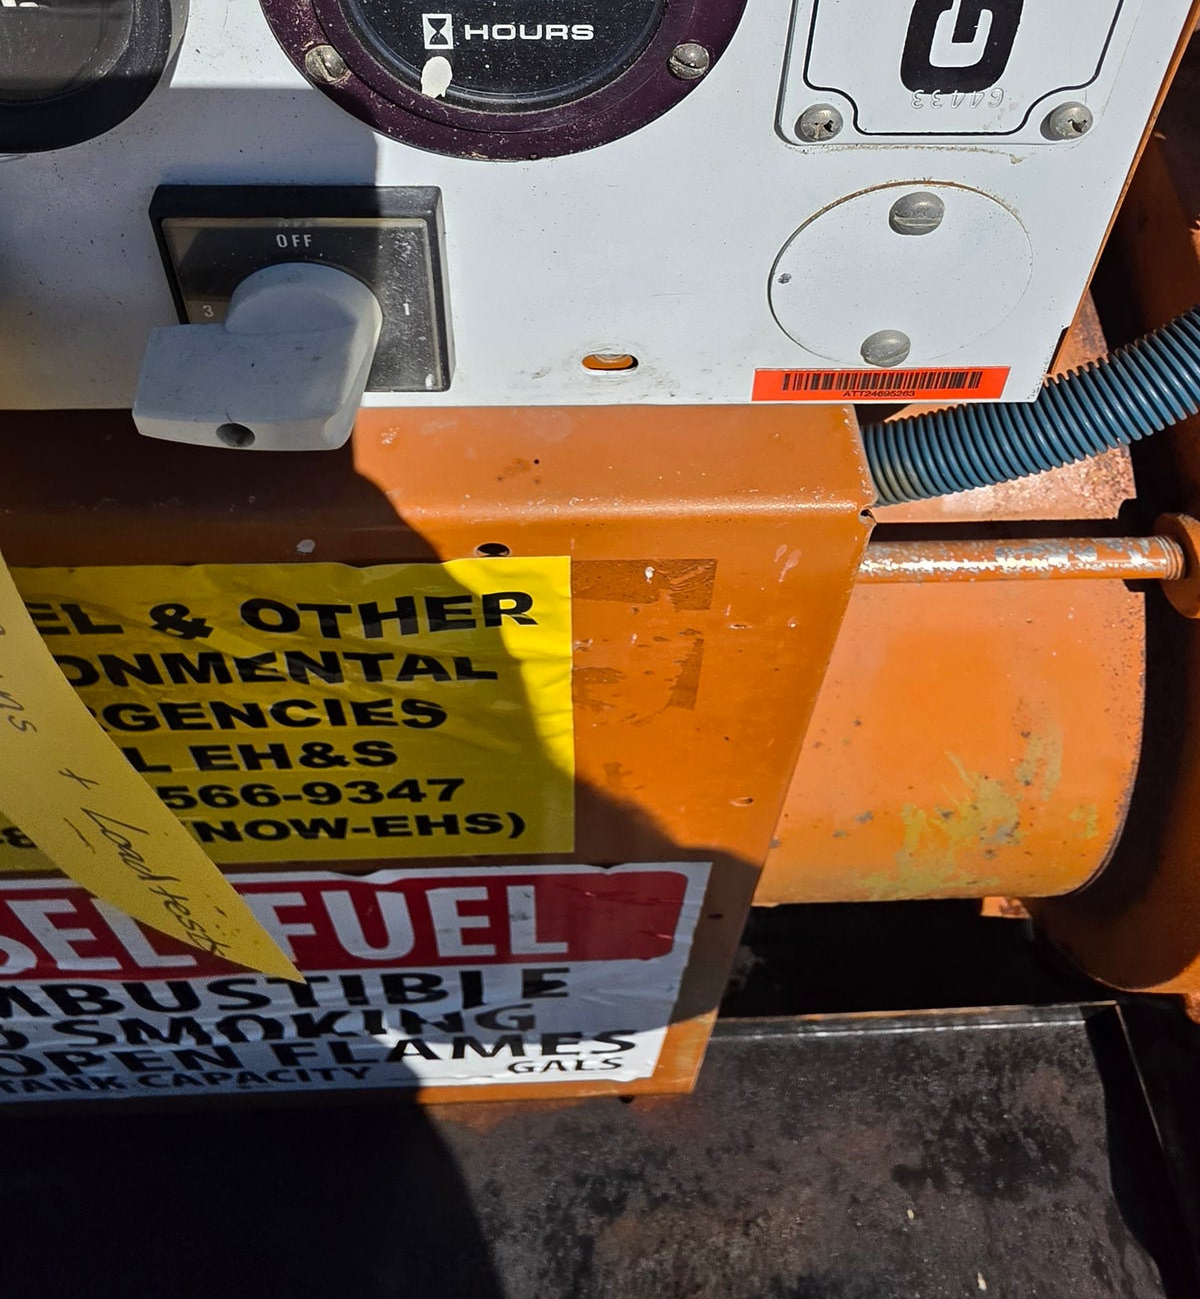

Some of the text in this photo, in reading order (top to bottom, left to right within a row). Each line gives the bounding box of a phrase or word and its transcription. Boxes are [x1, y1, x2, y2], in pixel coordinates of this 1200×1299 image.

[464, 24, 594, 41] HOURS
[276, 233, 312, 248] OFF
[203, 304, 214, 318] 3
[149, 602, 214, 640] &
[240, 591, 539, 639] OTHER
[88, 699, 448, 733] GENCIES
[188, 740, 398, 771] EH&S
[180, 812, 527, 843] NOW-EHS)
[243, 885, 568, 962] FUEL
[53, 1004, 537, 1048] SMOKING
[0, 1029, 639, 1078] OPEN FLAMES
[137, 1066, 373, 1089] CAPACITY
[507, 1056, 626, 1074] GALS
